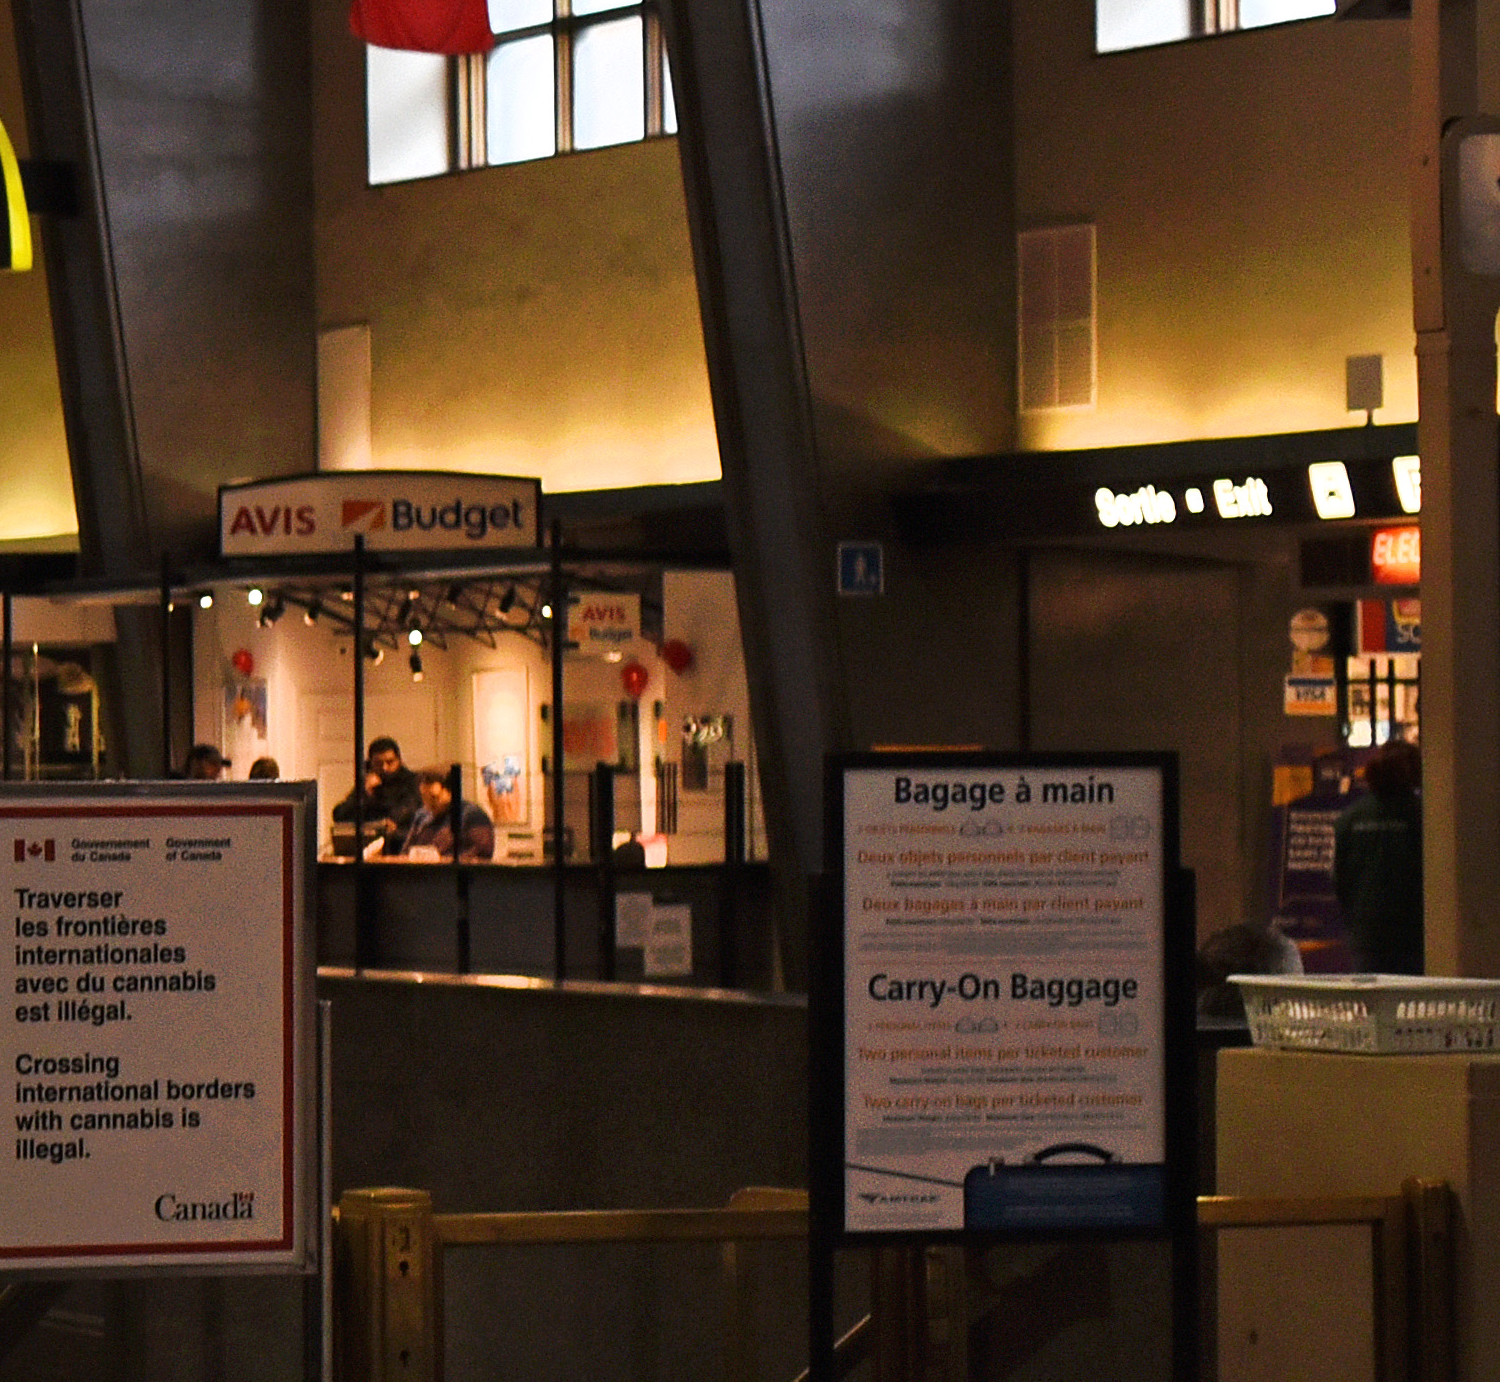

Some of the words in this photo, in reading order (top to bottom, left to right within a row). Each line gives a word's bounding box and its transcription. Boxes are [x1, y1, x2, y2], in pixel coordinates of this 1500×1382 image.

[1214, 477, 1272, 518] Exit
[229, 504, 317, 536] AVIS
[391, 498, 527, 540] Budget
[582, 605, 626, 622] AVIS
[893, 775, 1006, 811] Bagage
[1014, 775, 1032, 805] à
[1041, 775, 1115, 805] main
[70, 837, 151, 850] Gouvernement
[89, 850, 132, 863] Canada
[165, 837, 232, 850] Government
[180, 850, 223, 862] Canada
[14, 887, 124, 910] Traverser
[15, 916, 49, 938] les
[56, 913, 168, 938] frontières
[15, 943, 187, 966] internationales
[15, 975, 70, 995] avec
[76, 971, 106, 994] du
[112, 970, 217, 993] cannabis
[867, 972, 1001, 1009] Carry-On
[1009, 972, 1140, 1007] Baggage
[15, 1001, 50, 1023] est
[57, 998, 133, 1027] illégal.
[15, 1052, 120, 1078] Crossing
[15, 1080, 159, 1104] international
[166, 1078, 256, 1100] borders
[15, 1109, 63, 1132] with
[70, 1107, 175, 1131] cannabis
[181, 1106, 202, 1129] is
[15, 1137, 92, 1164] illegal.
[154, 1192, 255, 1222] Canada
